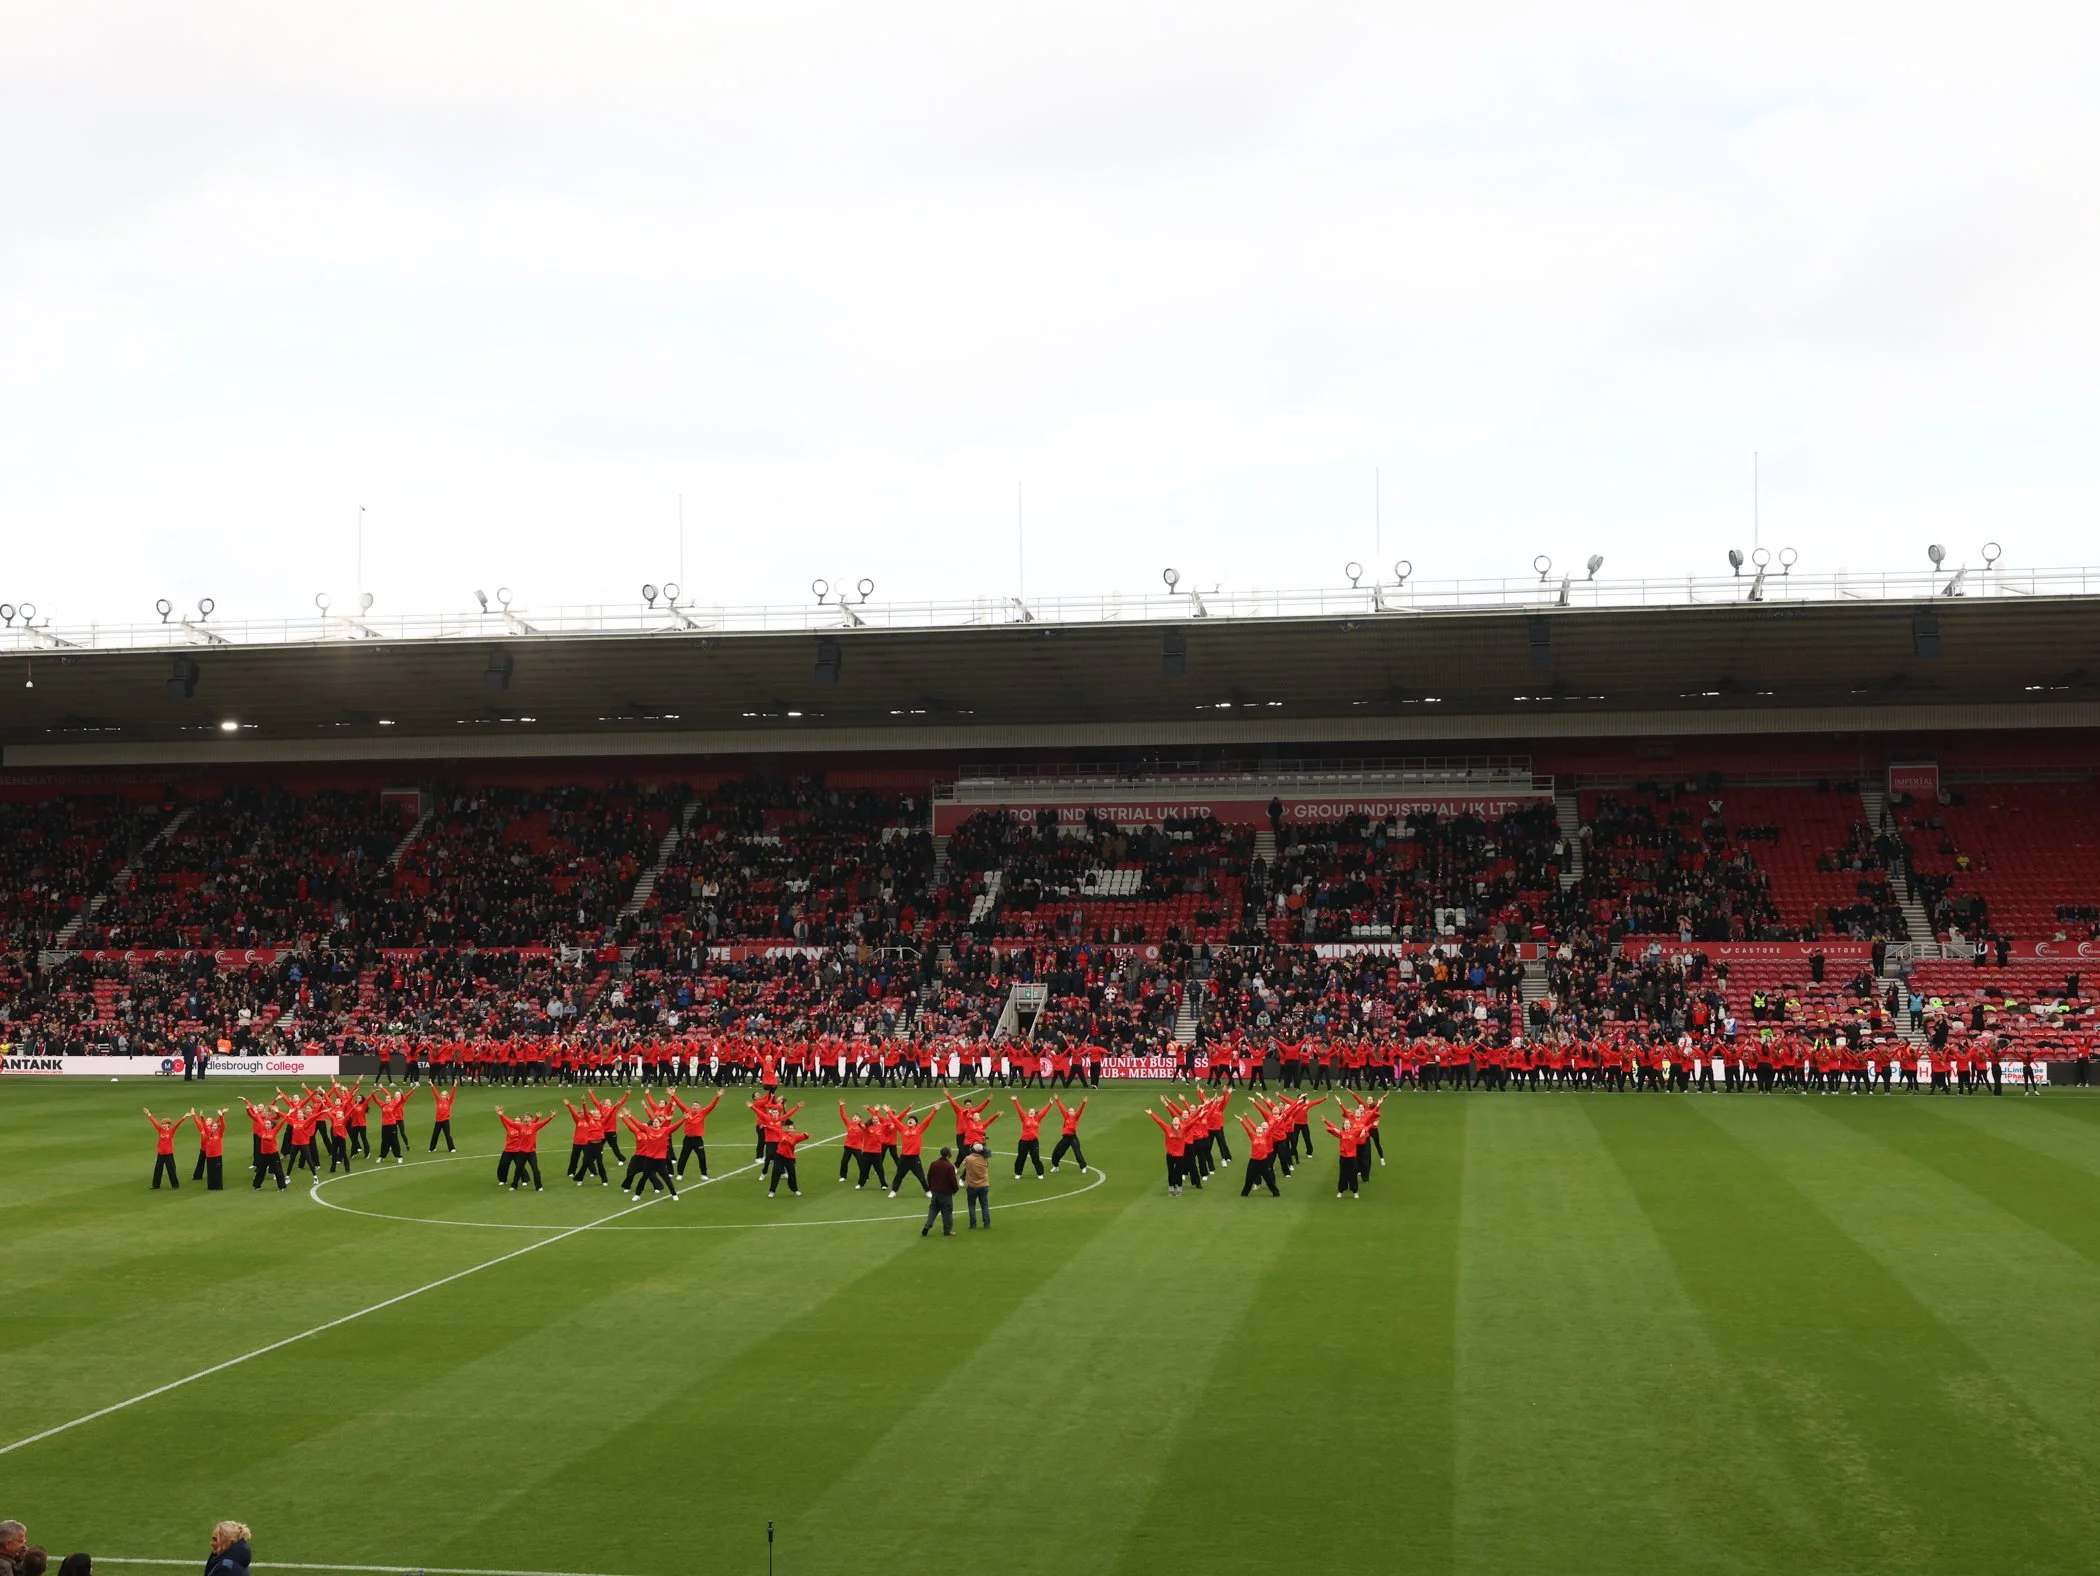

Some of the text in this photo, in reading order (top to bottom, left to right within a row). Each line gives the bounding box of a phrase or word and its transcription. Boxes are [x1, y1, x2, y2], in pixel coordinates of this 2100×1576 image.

[1894, 776, 1933, 785] IMPERIAL
[1157, 806, 1179, 820] UK
[1294, 803, 1354, 817] GROUP
[1358, 802, 1459, 817] INDUSTRIAL
[265, 1061, 305, 1073] College
[1150, 1057, 1209, 1068] BUSISS
